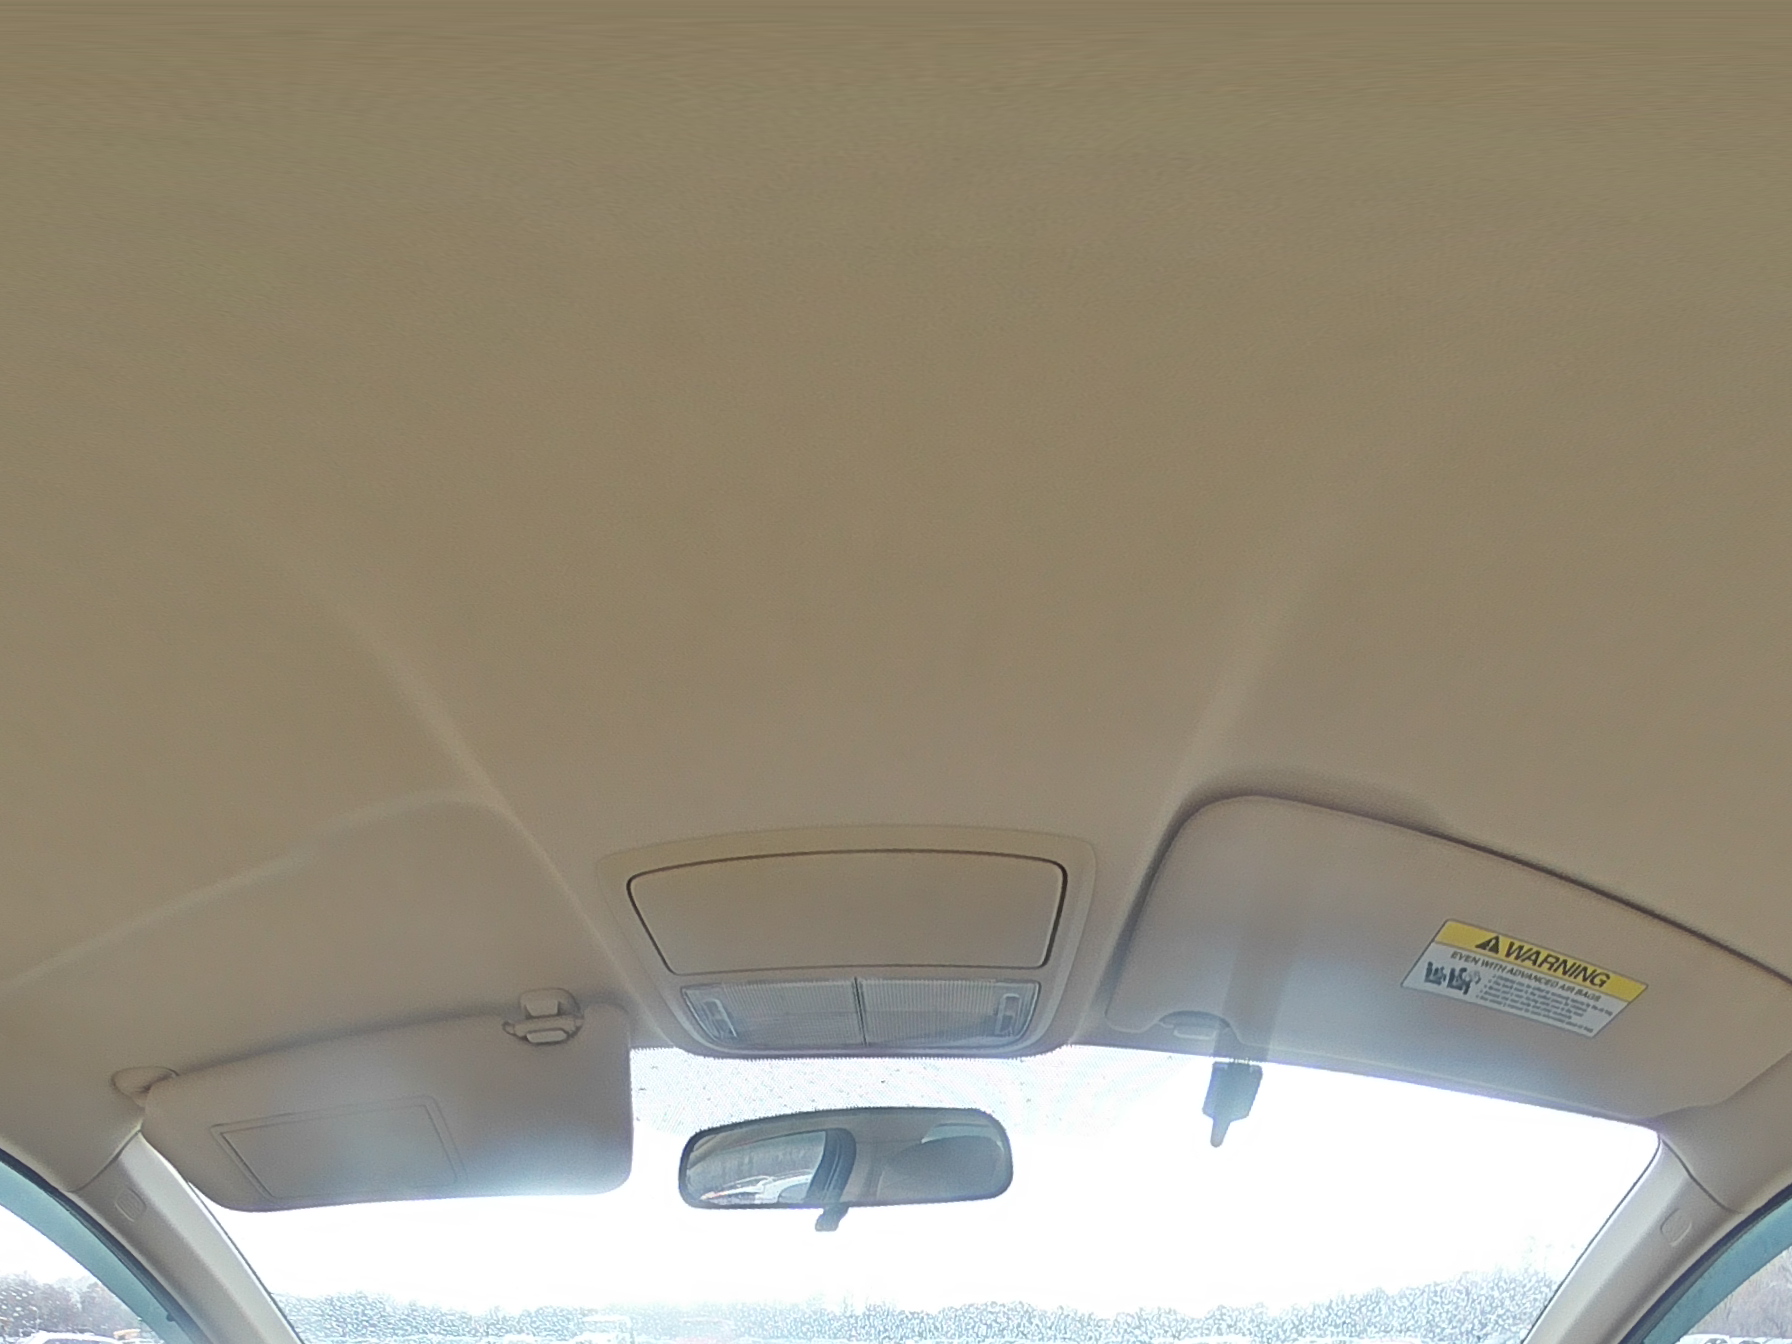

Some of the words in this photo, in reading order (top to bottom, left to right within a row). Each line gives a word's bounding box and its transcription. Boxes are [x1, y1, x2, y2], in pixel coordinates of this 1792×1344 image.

[1450, 950, 1480, 966] EVEN
[1481, 959, 1505, 973] WITH
[1507, 967, 1559, 988] ADVANCED
[1558, 983, 1575, 993] AIR
[1574, 988, 1602, 1002] BAGS
[1505, 941, 1611, 989] WARNING
